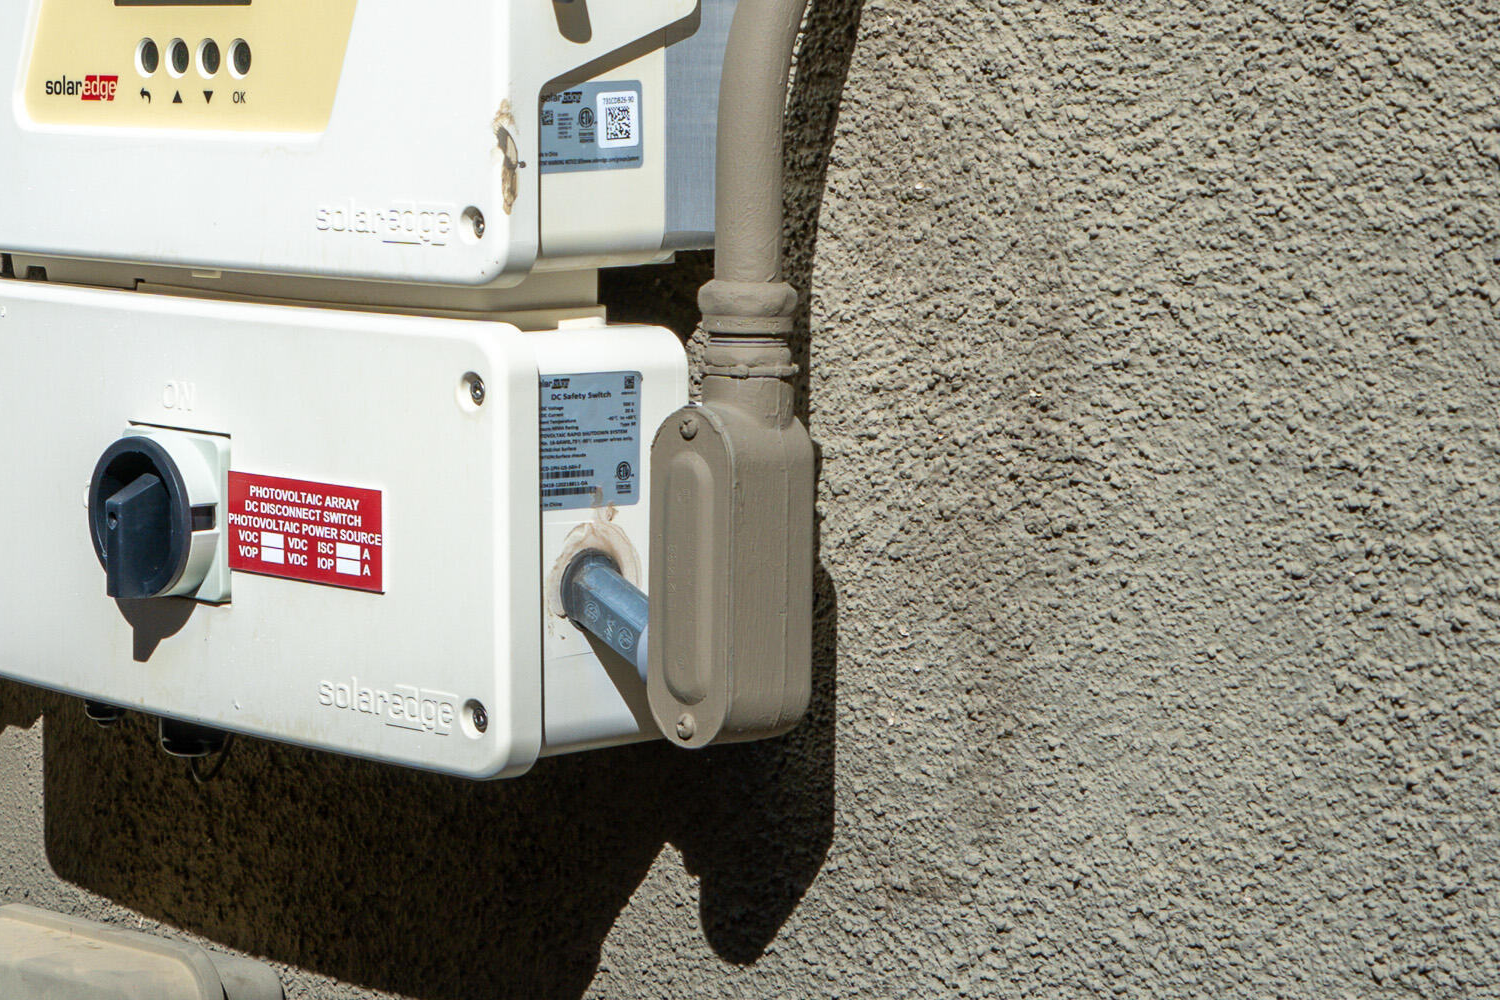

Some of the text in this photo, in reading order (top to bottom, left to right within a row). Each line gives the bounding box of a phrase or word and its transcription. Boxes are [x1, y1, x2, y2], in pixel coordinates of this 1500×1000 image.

[45, 75, 118, 101] solaredge
[232, 92, 246, 104] OK
[588, 390, 611, 399] Switch
[249, 485, 359, 511] PHOTOVOLTAIC ARRAY
[245, 500, 361, 527] DC DISCONNECT SWITCH
[228, 513, 382, 546] PHOTOVOLTAIC POWER SOURCE
[238, 530, 371, 560] VOC VDC ISC A
[238, 545, 371, 576] VOP VDC IOP A
[317, 676, 458, 736] solaredge
